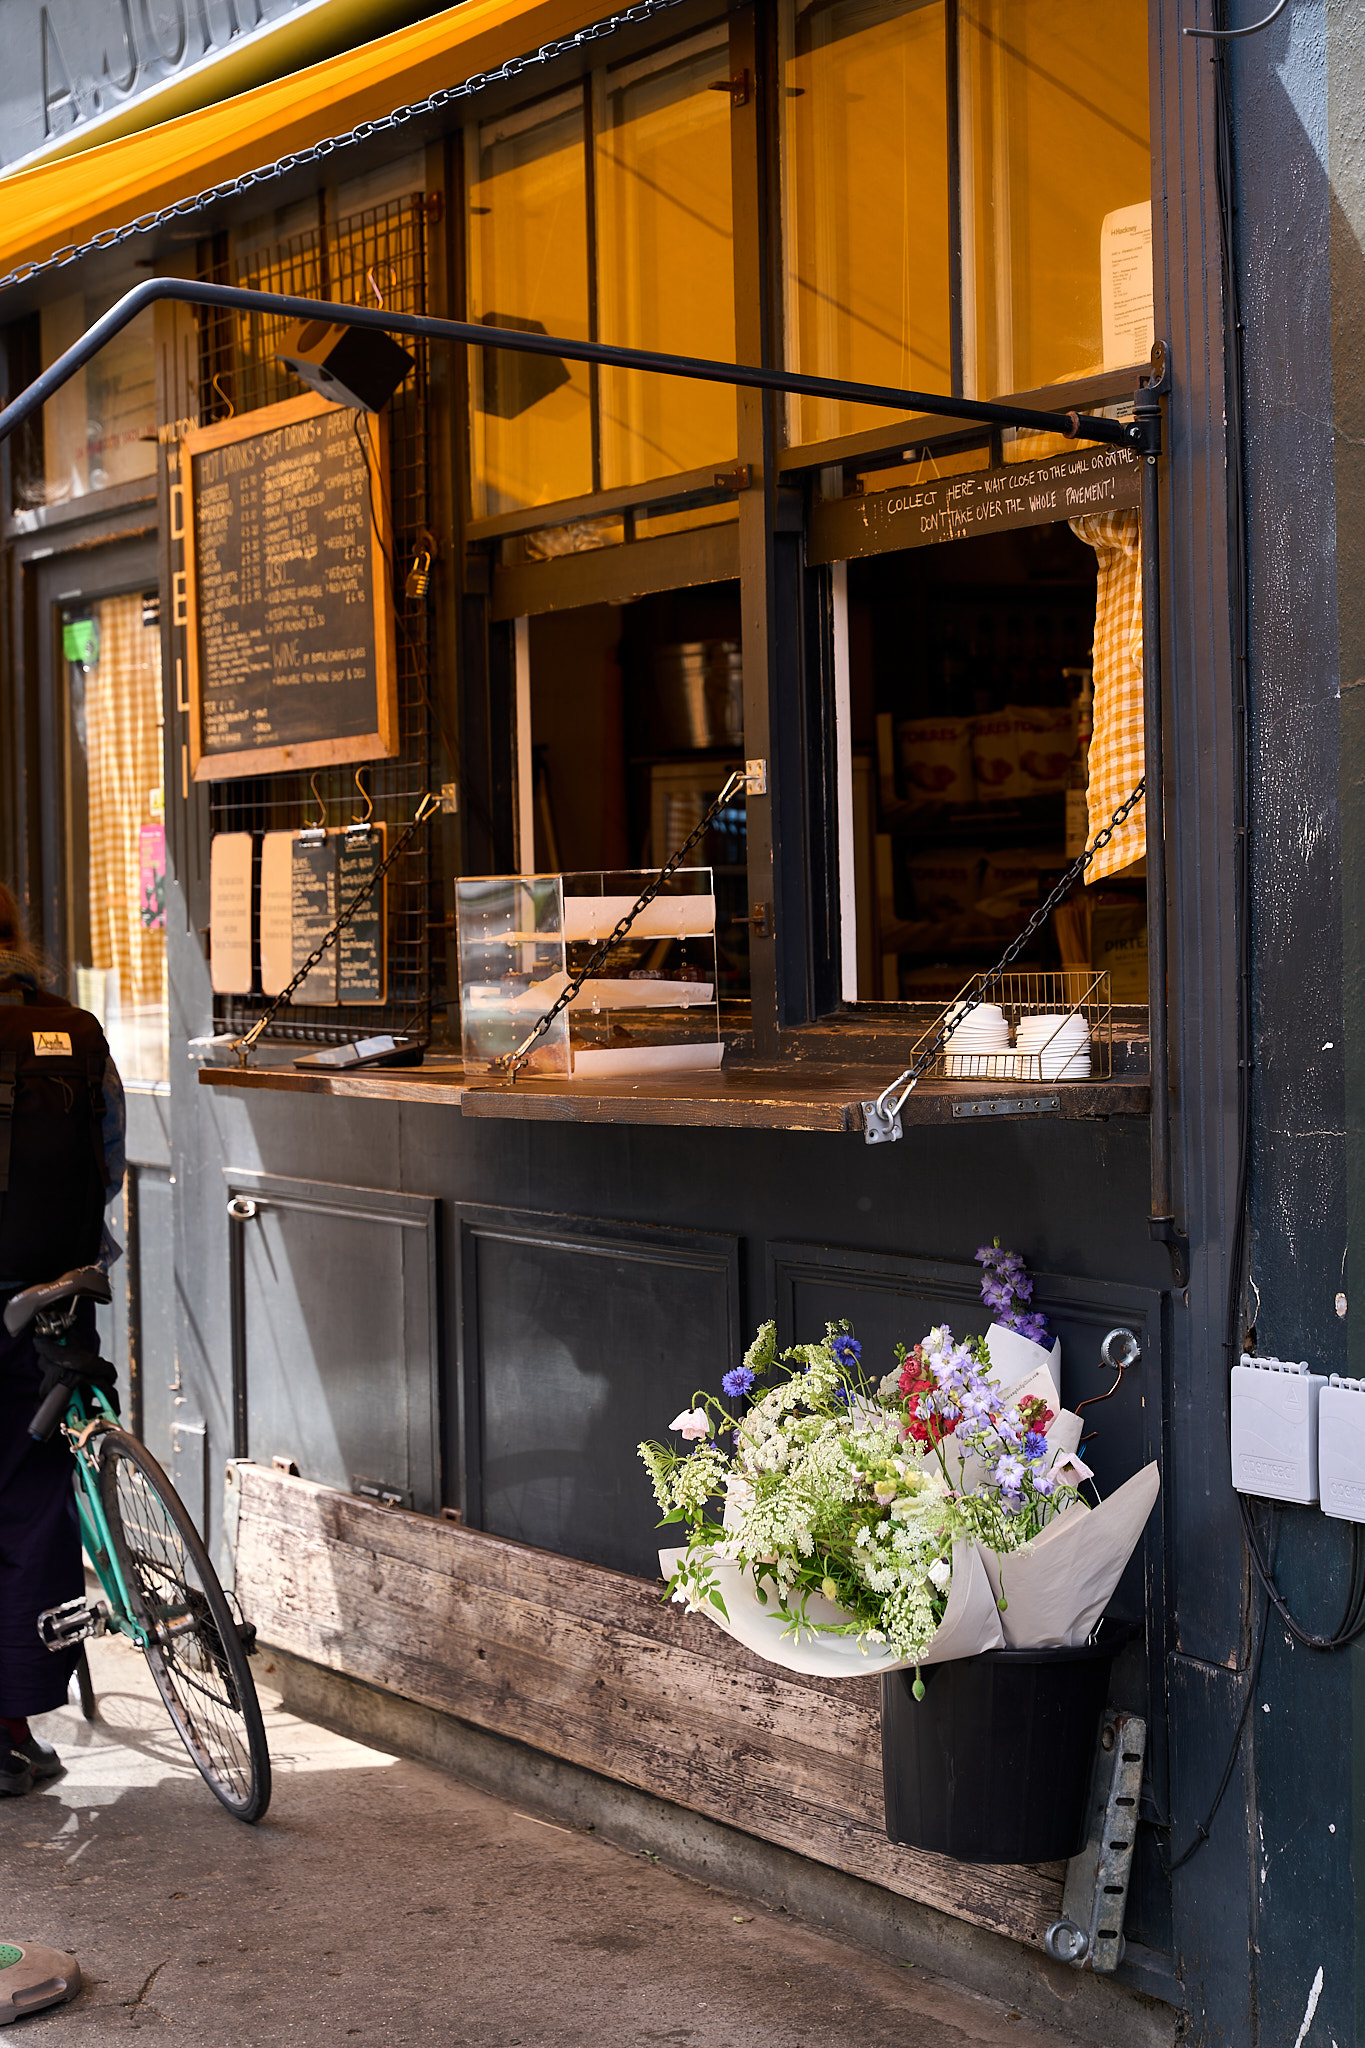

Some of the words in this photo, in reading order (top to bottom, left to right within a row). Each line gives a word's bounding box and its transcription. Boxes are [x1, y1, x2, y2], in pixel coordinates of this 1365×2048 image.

[887, 491, 937, 515] COLLECT
[946, 480, 976, 501] HERE
[984, 477, 1007, 494] WAIT
[1009, 471, 1035, 489] CLOSE
[1037, 470, 1049, 481] TO
[1050, 464, 1067, 479] THE
[1068, 460, 1090, 475] WALL
[1091, 455, 1104, 469] OR
[1105, 451, 1117, 467] ON
[1117, 448, 1134, 465] THE
[949, 505, 975, 527] TAKE
[977, 500, 1003, 521] OVER
[1005, 499, 1025, 514] THE
[1029, 490, 1057, 512] WHOLE
[1065, 477, 1115, 506] PAVEMENT!
[1104, 937, 1147, 954] DIRTE
[1240, 1458, 1297, 1483] openreach
